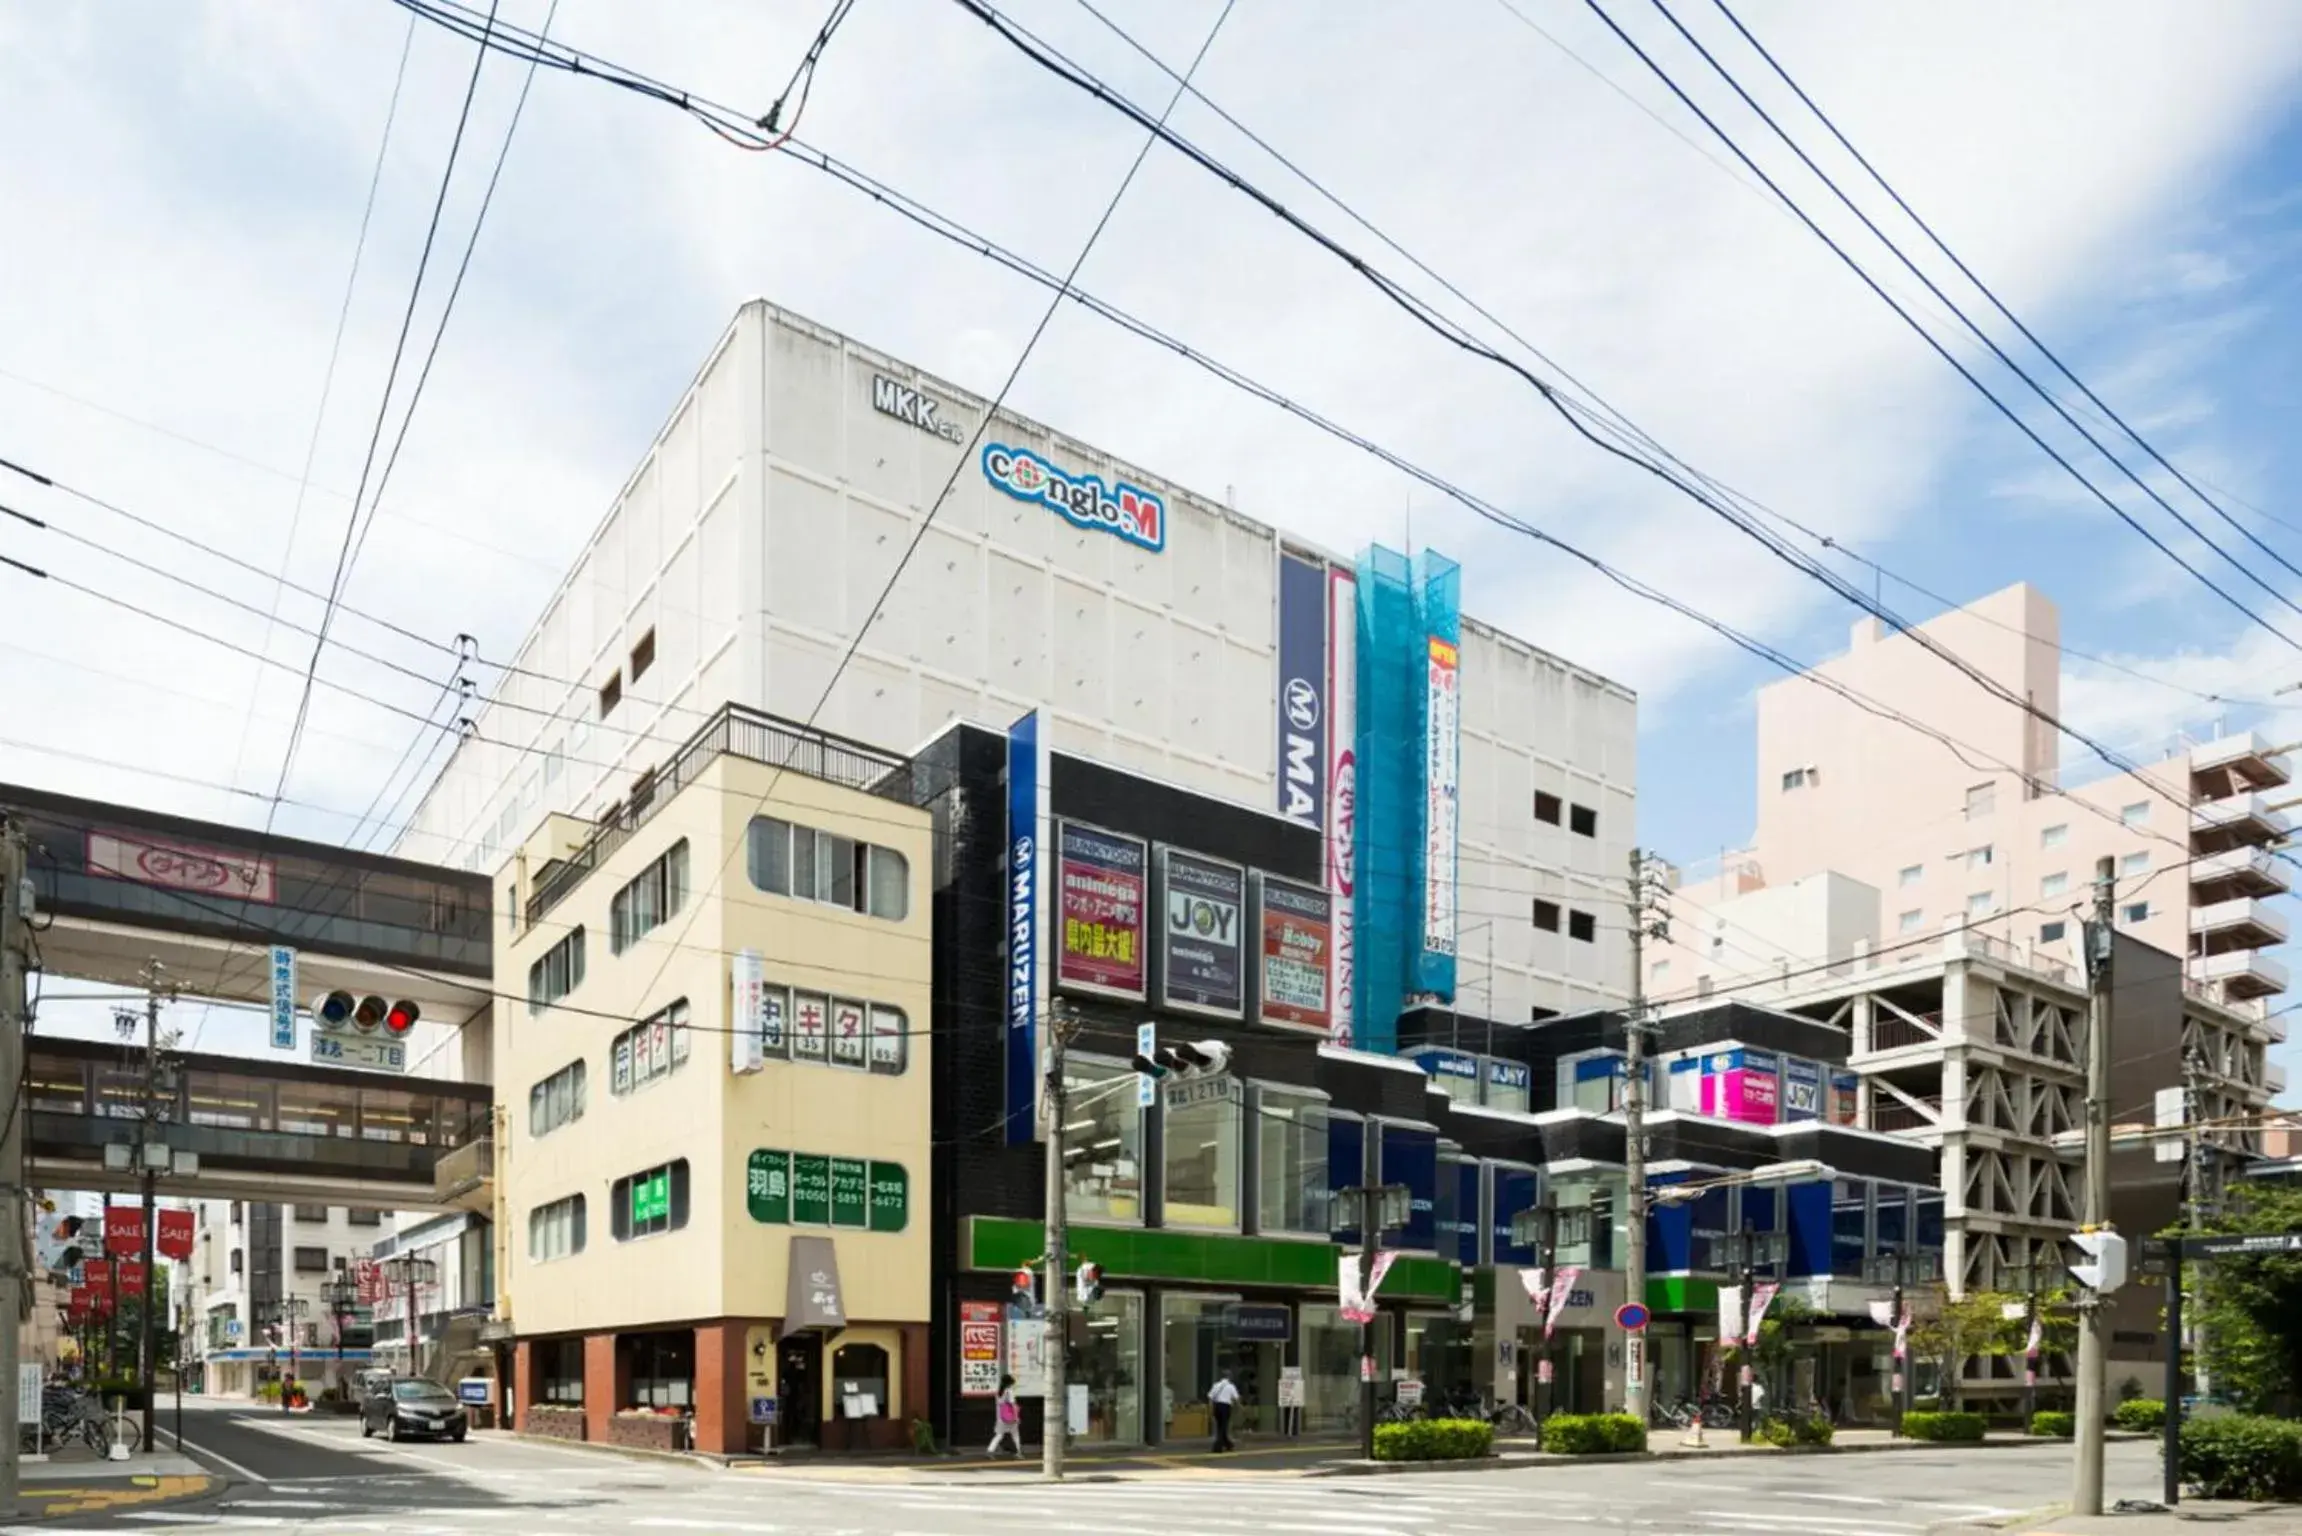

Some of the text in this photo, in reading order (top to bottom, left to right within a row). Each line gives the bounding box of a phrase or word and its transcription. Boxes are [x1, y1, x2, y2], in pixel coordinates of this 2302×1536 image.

[1171, 897, 1234, 941] JOY
[1013, 870, 1031, 1028] MARUZEN
[1339, 911, 1352, 1009] DAISO
[799, 1004, 898, 1040] ギター
[1789, 1085, 1816, 1110] JOY
[109, 1222, 140, 1236] SALE
[161, 1226, 190, 1239] SALE
